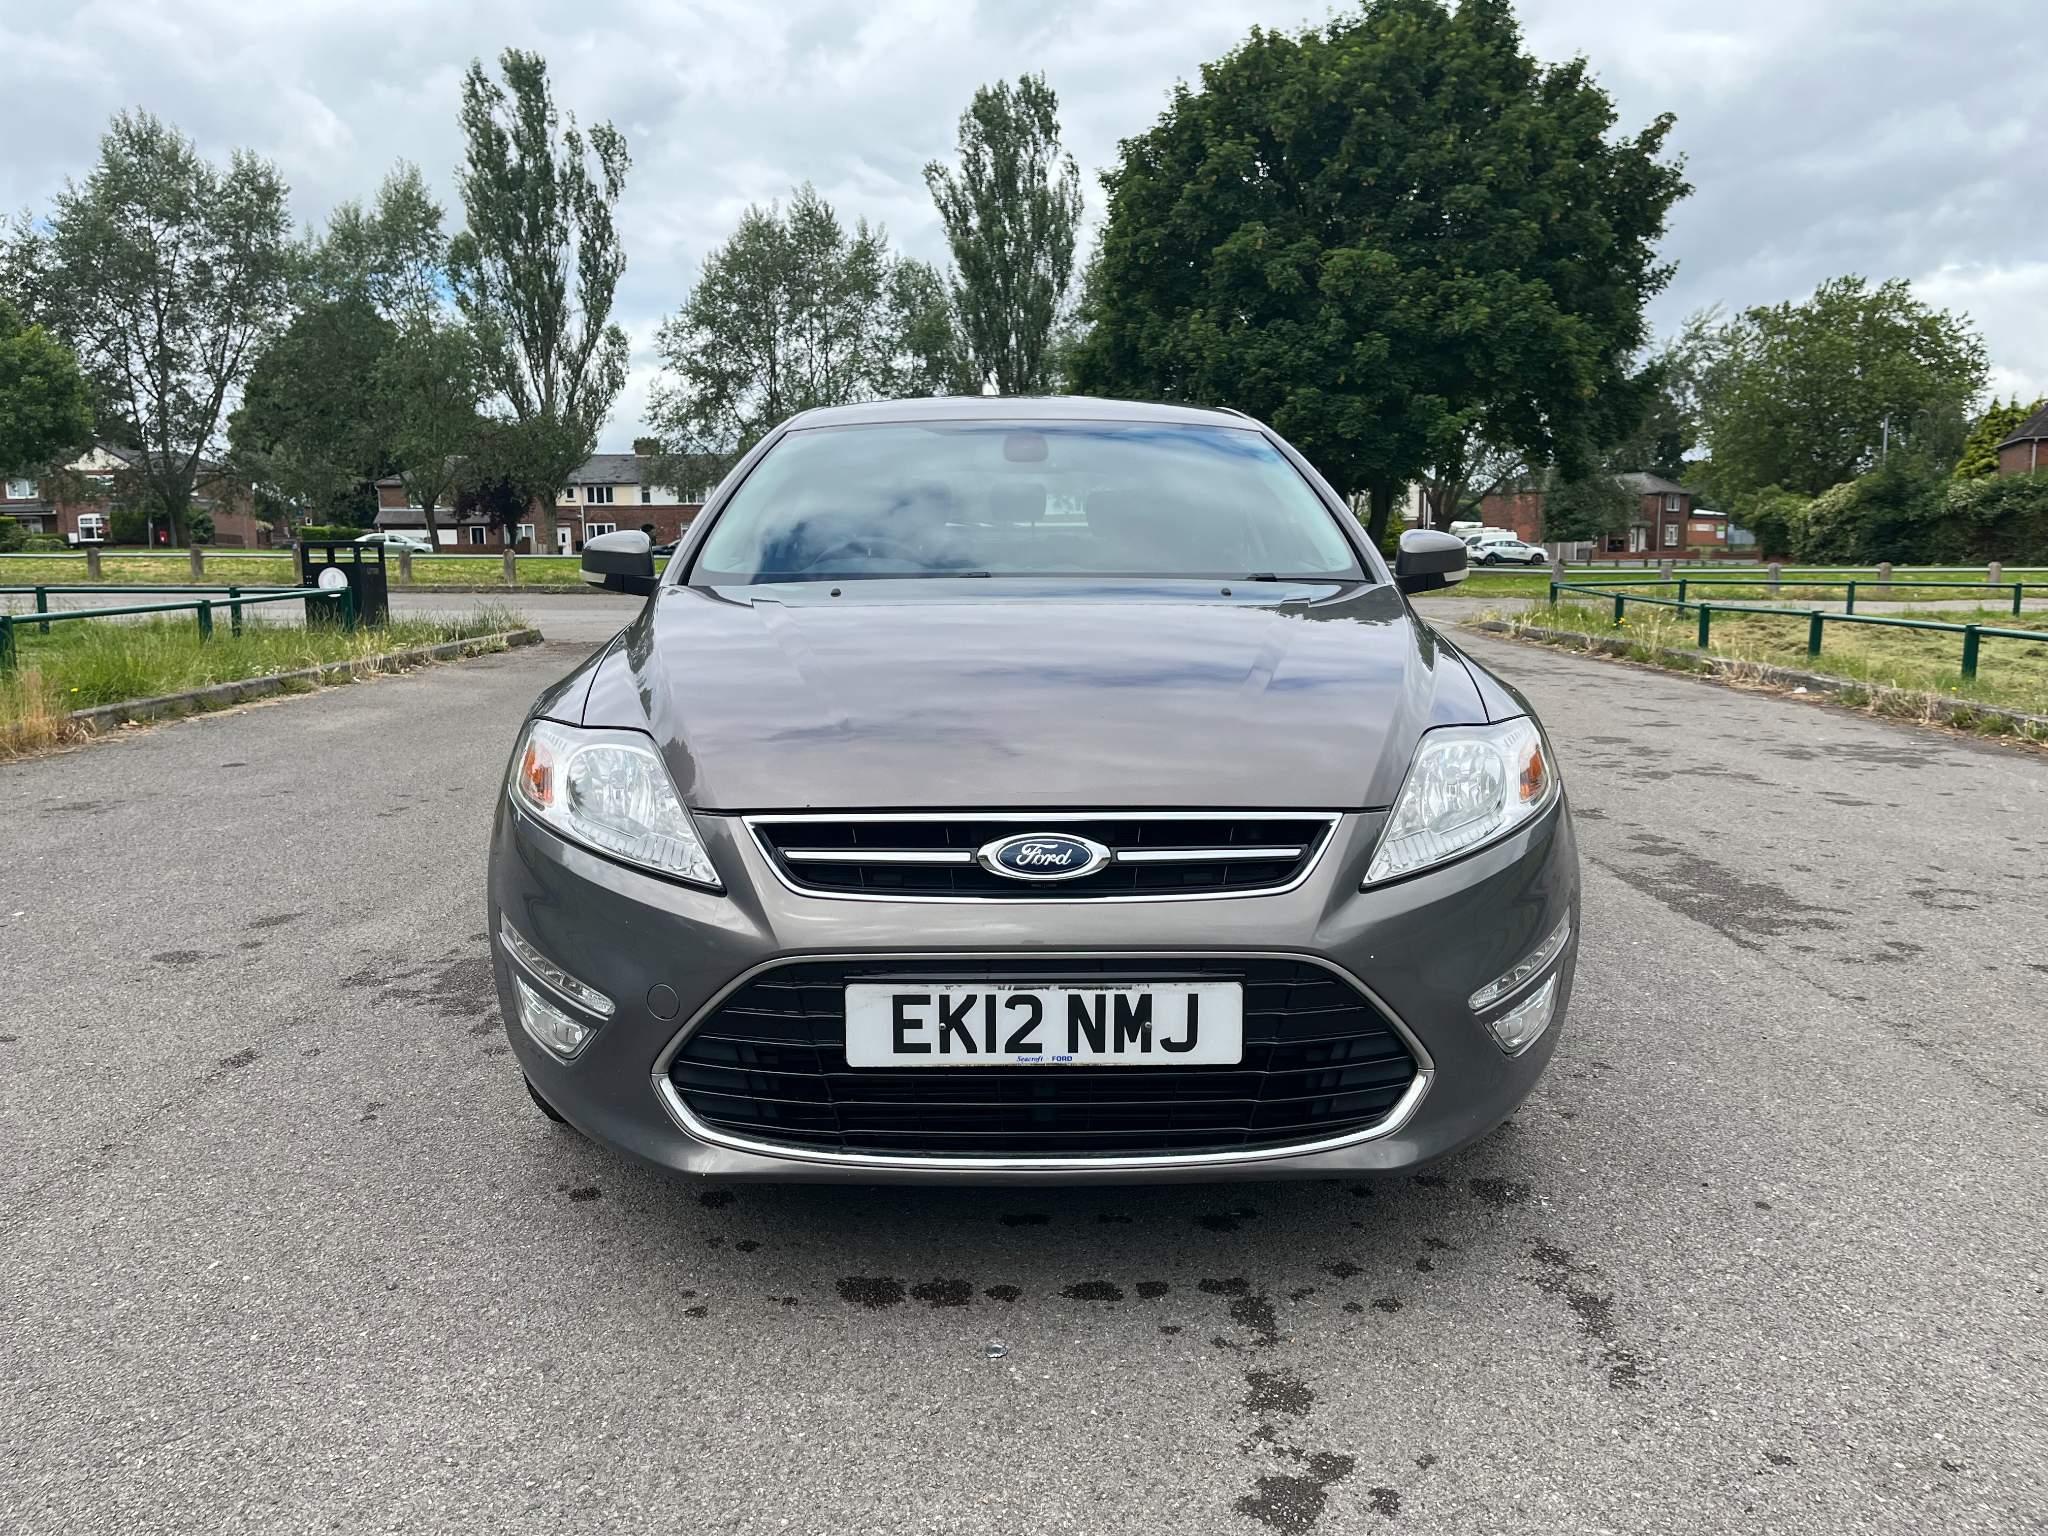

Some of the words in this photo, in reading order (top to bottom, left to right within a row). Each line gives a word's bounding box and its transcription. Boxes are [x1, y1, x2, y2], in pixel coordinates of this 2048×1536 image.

[1016, 843, 1072, 866] Ford
[892, 994, 1043, 1054] EK12
[1067, 993, 1199, 1054] NMJ
